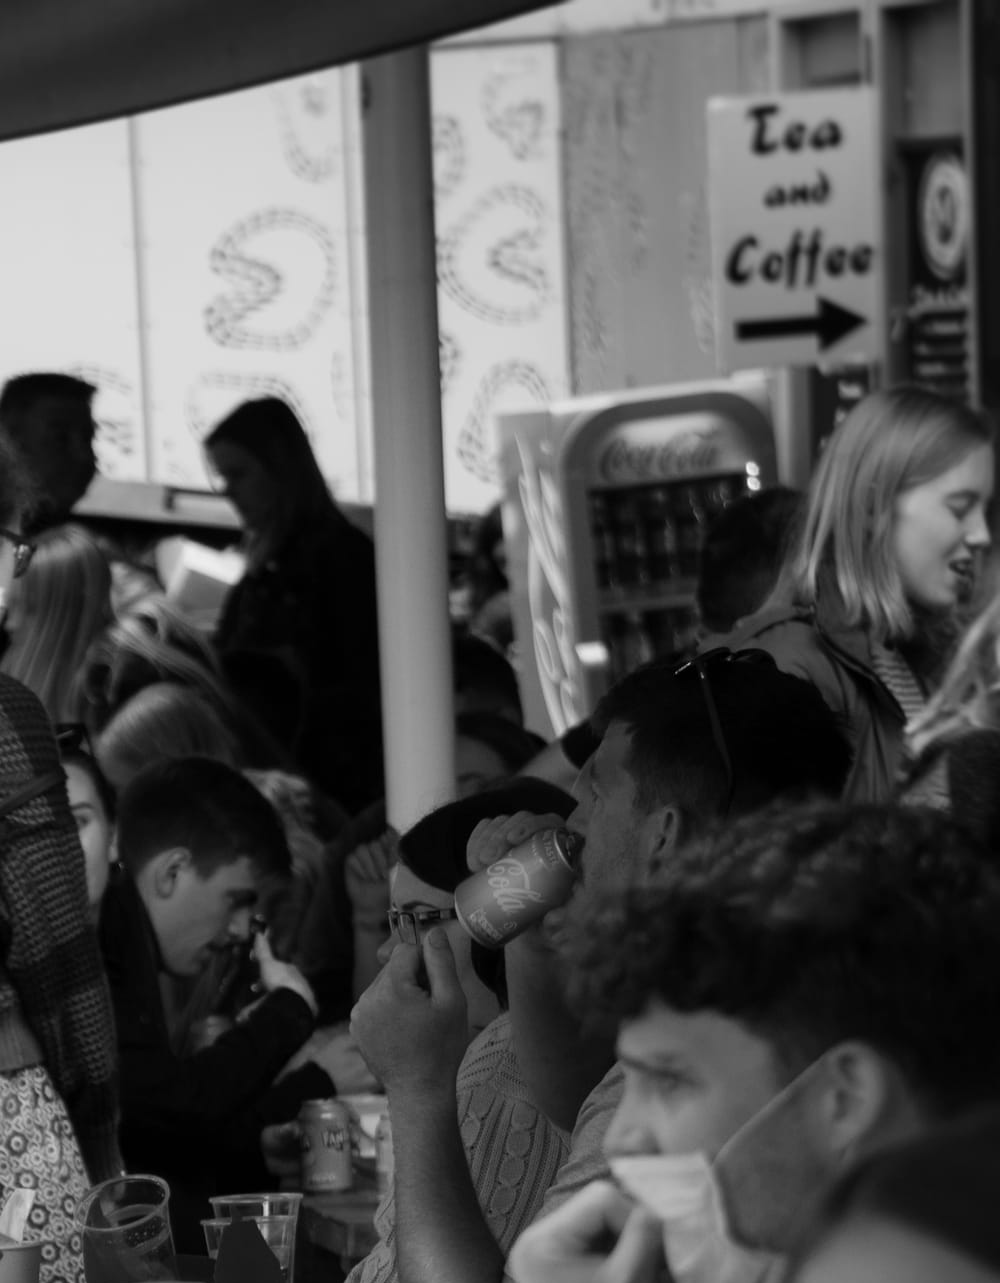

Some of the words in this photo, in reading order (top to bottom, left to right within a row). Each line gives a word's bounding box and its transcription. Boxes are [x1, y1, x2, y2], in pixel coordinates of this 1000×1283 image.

[746, 103, 844, 155] Tea
[763, 171, 832, 209] and
[725, 228, 874, 289] Coffee
[486, 858, 546, 912] Cola
